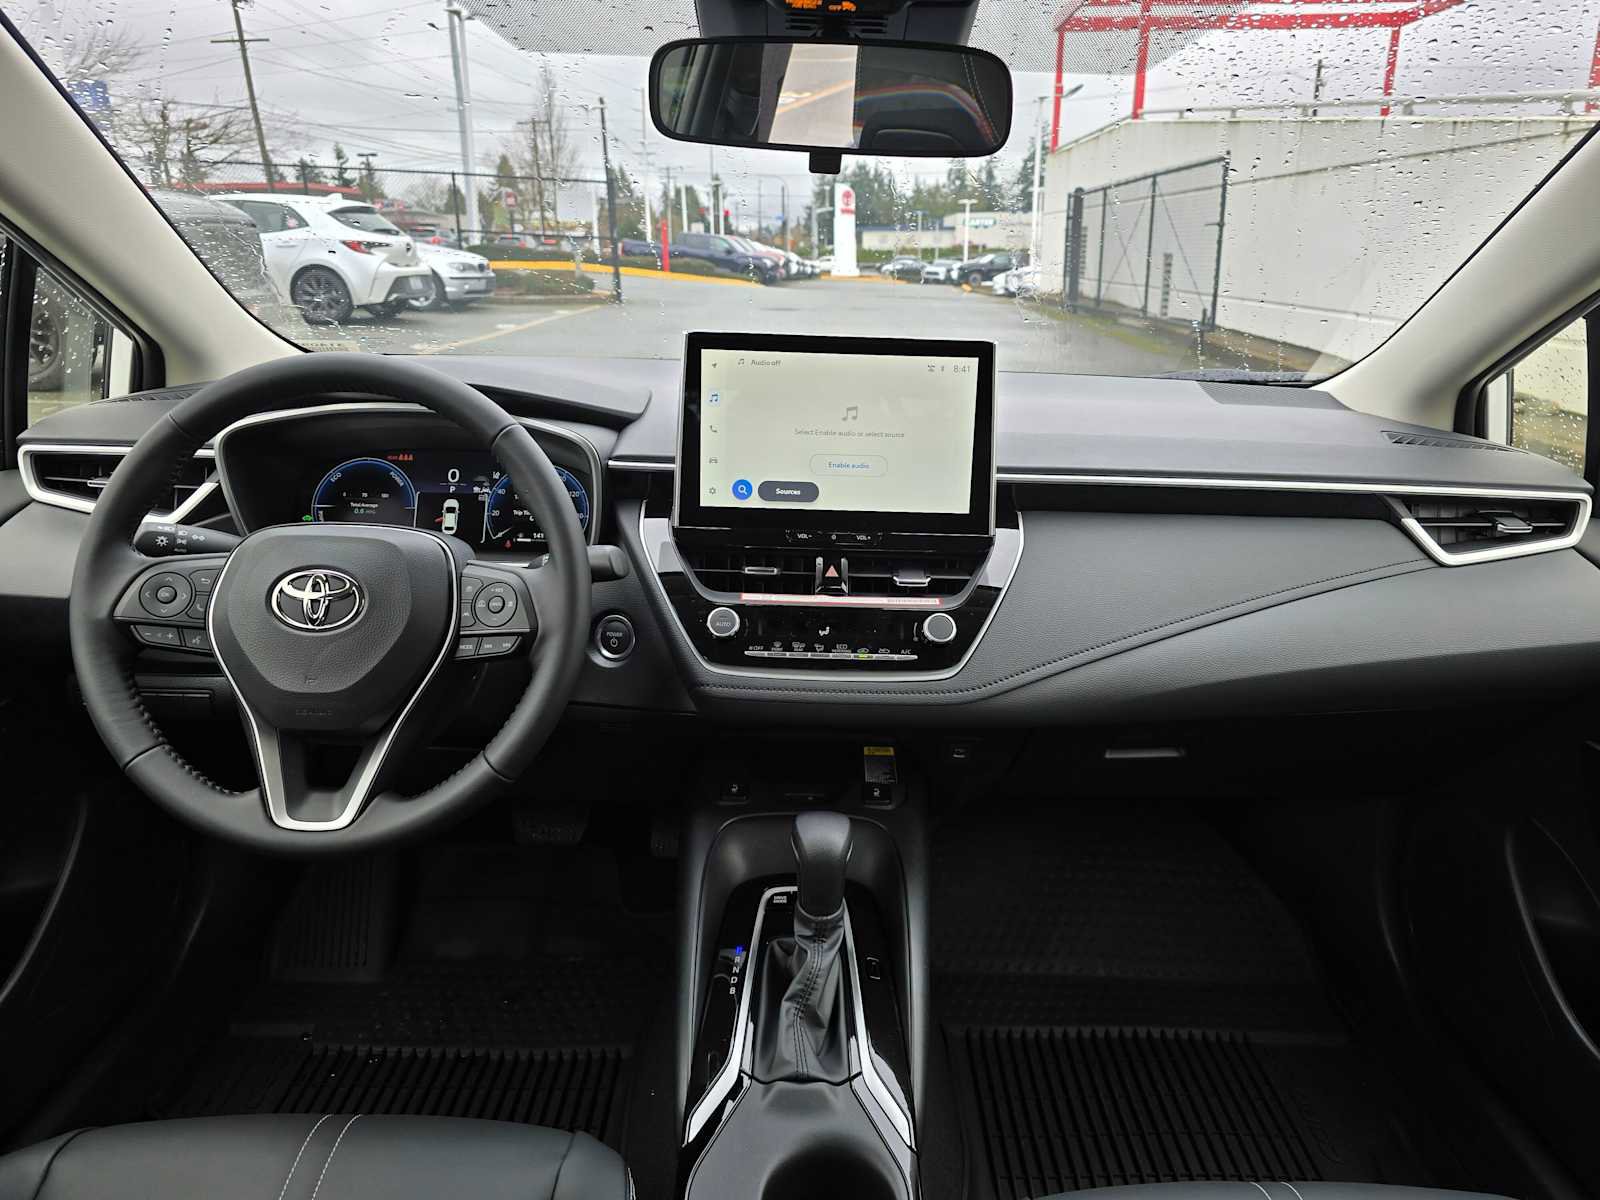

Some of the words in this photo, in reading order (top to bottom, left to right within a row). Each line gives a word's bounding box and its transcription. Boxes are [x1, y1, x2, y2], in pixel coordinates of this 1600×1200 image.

[751, 359, 769, 367] Audio
[770, 359, 781, 367] off
[953, 365, 971, 374] 8:41
[795, 428, 814, 436] Select
[815, 428, 837, 437] Enable
[828, 460, 850, 469] Enable
[851, 461, 870, 469] audio
[449, 486, 457, 494] P
[732, 966, 740, 974] N
[731, 976, 738, 984] D
